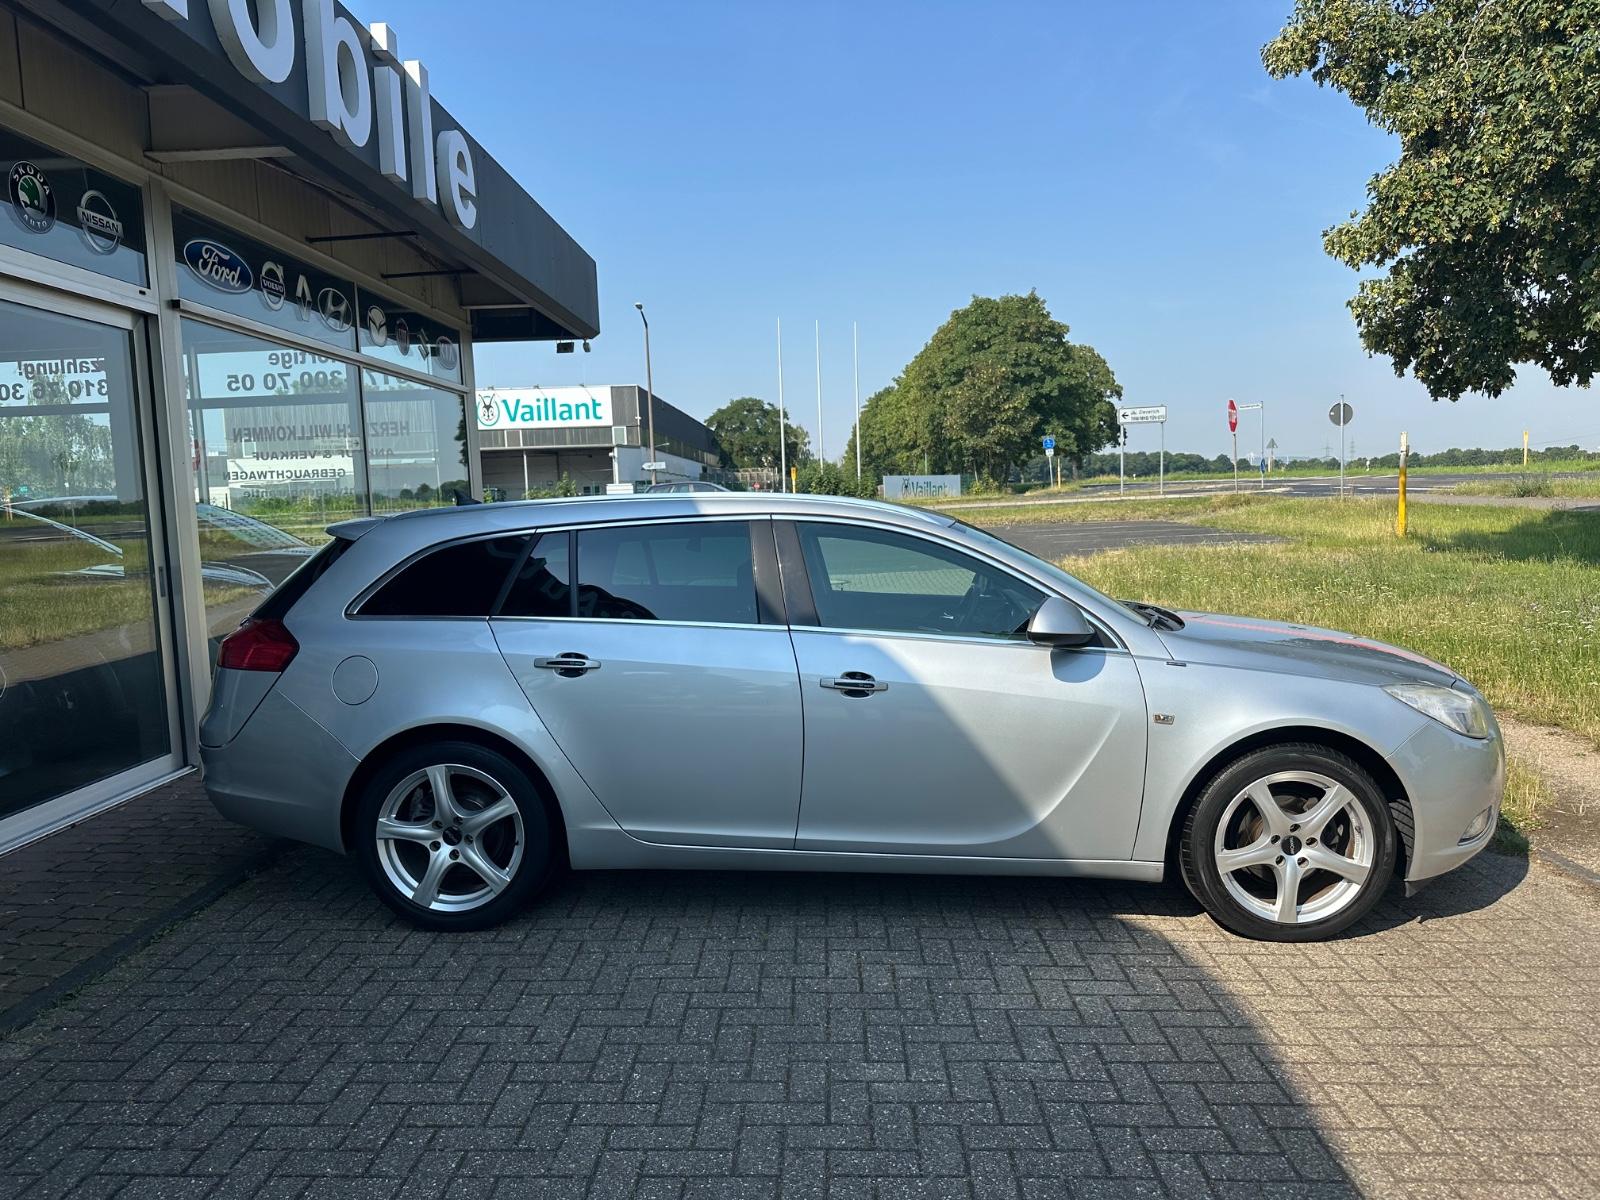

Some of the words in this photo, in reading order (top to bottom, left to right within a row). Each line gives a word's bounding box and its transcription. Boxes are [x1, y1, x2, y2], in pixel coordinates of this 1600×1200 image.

[143, 0, 476, 229] obile
[23, 214, 47, 229] AUTO
[81, 211, 119, 233] NISSAN
[199, 245, 241, 288] Ford
[262, 279, 284, 293] VOLVO
[502, 398, 603, 422] Vaillant
[912, 480, 947, 497] Vaillant
